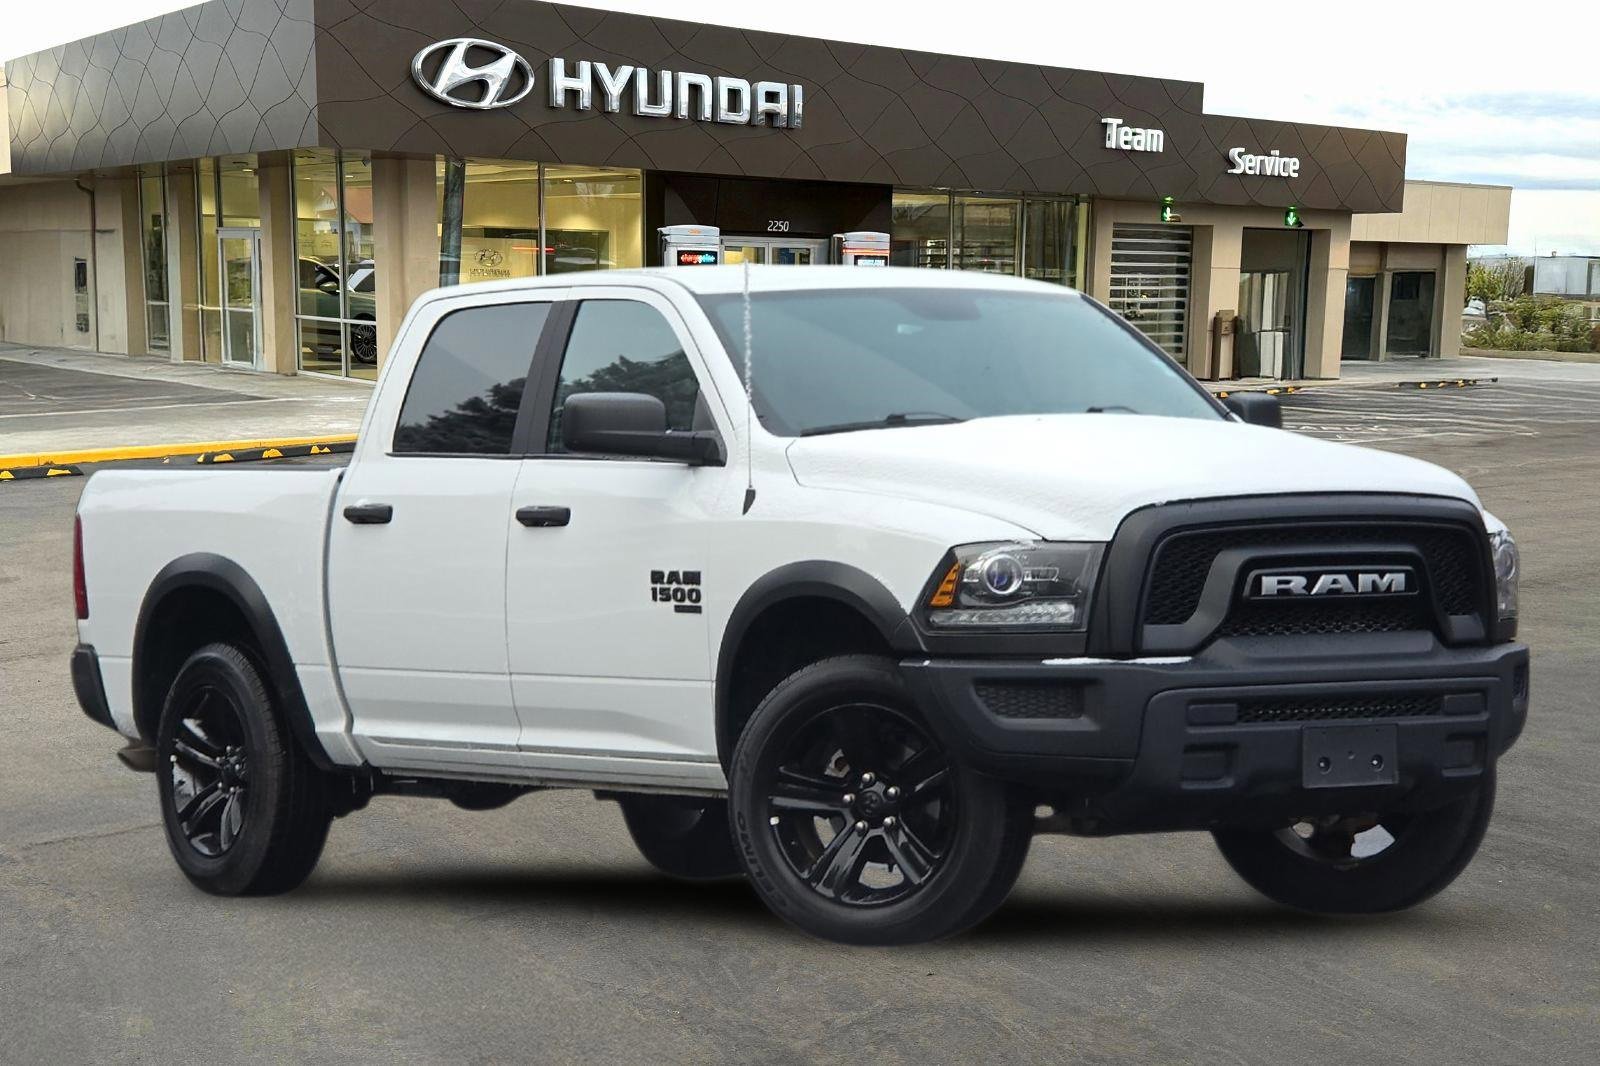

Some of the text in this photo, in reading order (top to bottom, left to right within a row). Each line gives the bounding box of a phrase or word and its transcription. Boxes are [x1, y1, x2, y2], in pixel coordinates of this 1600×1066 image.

[549, 57, 803, 129] HYUNDAI
[1102, 117, 1164, 153] Team
[1227, 147, 1300, 178] Service
[767, 220, 790, 232] 2250
[651, 570, 702, 585] RAM
[1260, 572, 1406, 596] RAM
[651, 587, 702, 604] 1500
